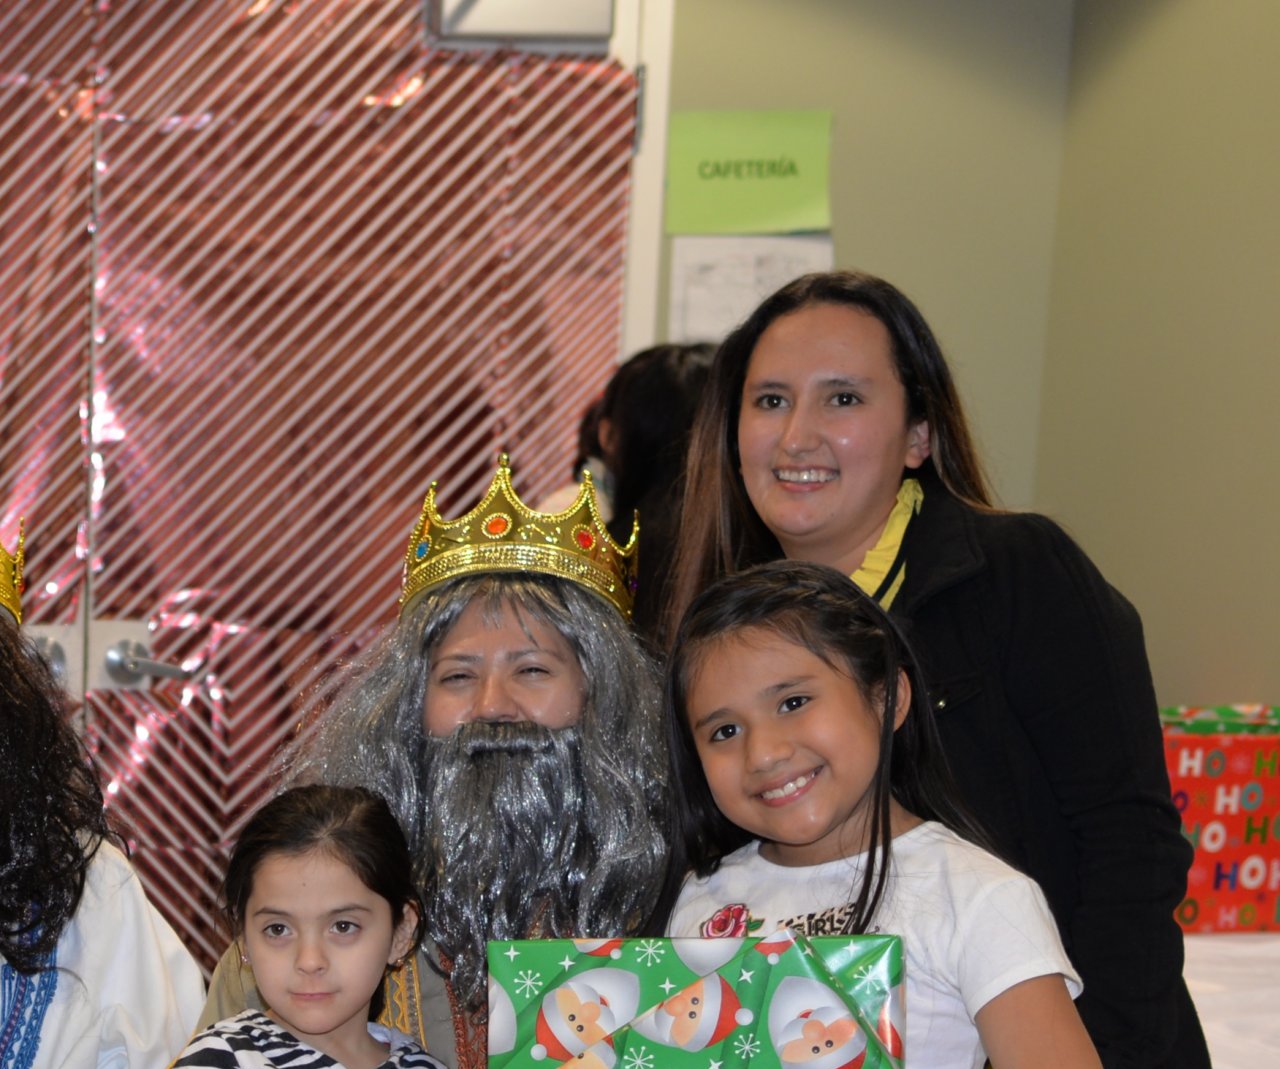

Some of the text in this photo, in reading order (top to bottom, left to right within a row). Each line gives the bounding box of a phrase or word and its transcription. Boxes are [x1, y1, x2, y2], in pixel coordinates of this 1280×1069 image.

[698, 154, 798, 179] CAFETERÍA
[1178, 748, 1226, 778] HO
[1214, 782, 1264, 814] HO
